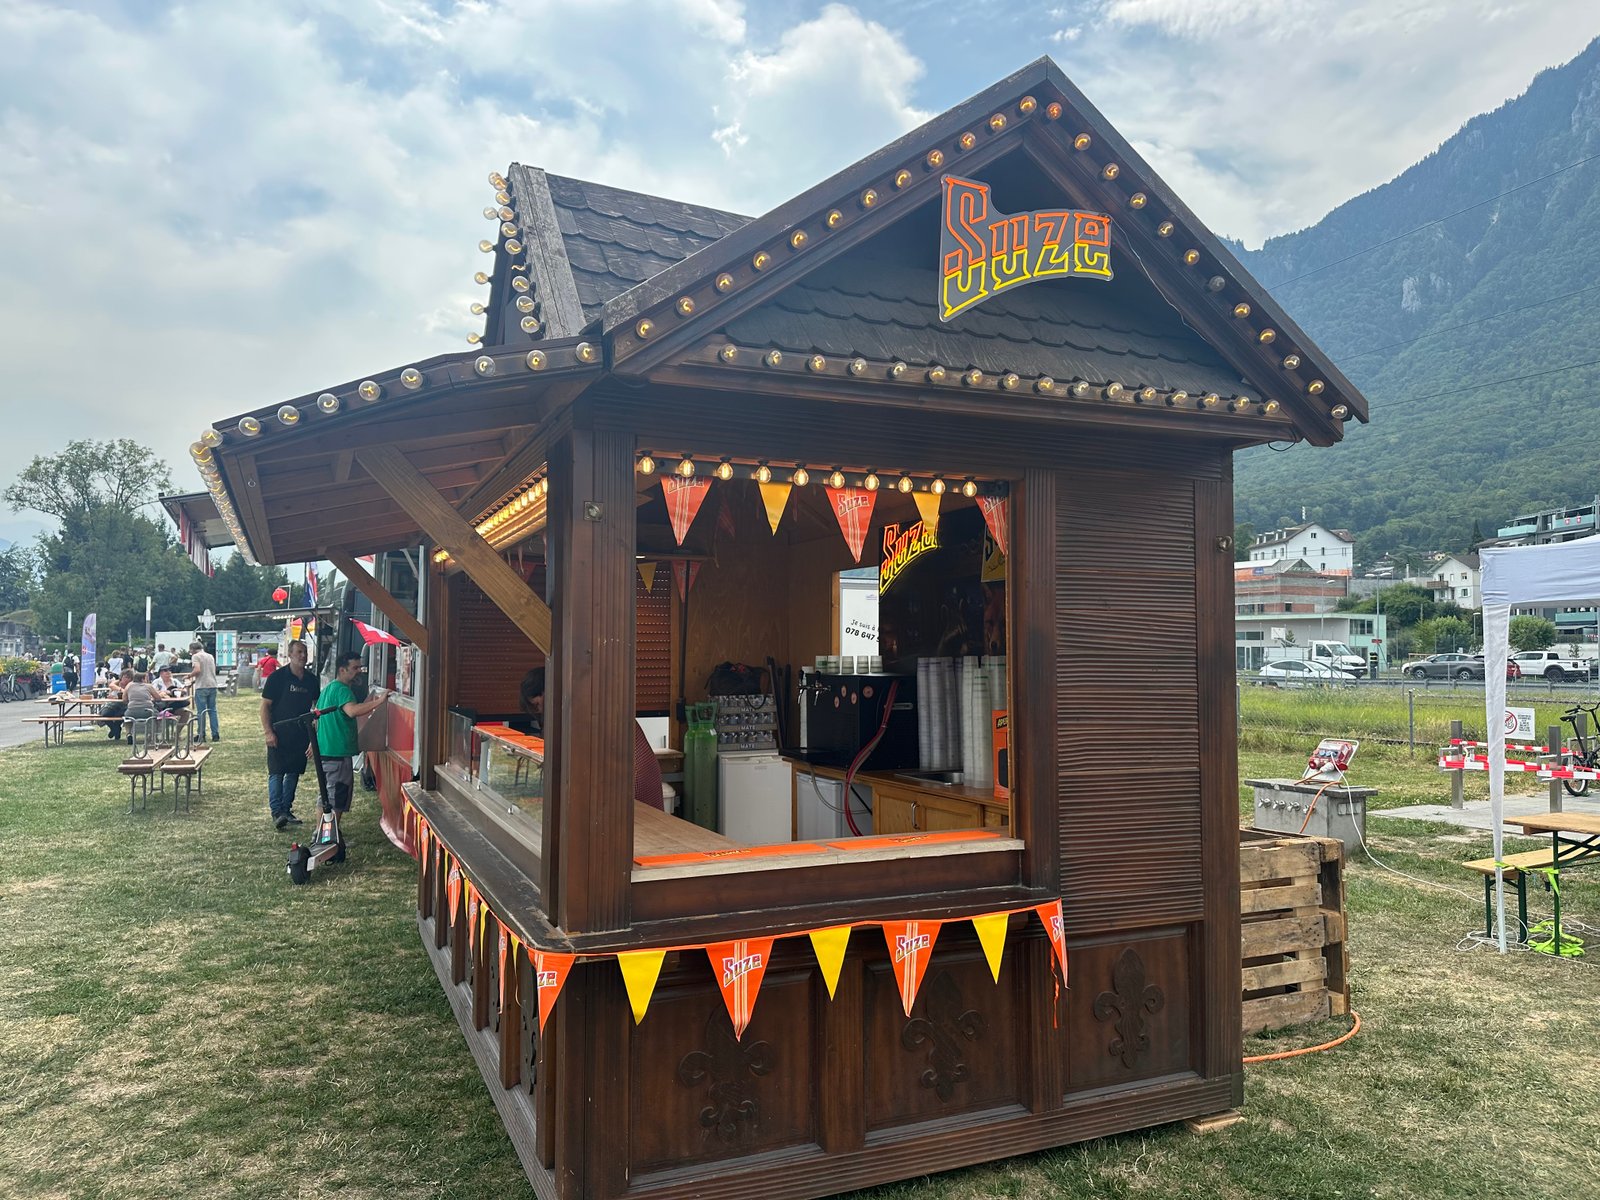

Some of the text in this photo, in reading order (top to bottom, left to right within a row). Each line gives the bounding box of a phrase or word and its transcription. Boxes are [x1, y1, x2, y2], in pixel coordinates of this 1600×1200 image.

[944, 176, 1113, 318] Suze
[837, 493, 870, 517] Suze
[846, 627, 859, 636] 078
[861, 632, 875, 641] 647
[895, 932, 931, 963] Suze
[722, 953, 762, 987] Suze
